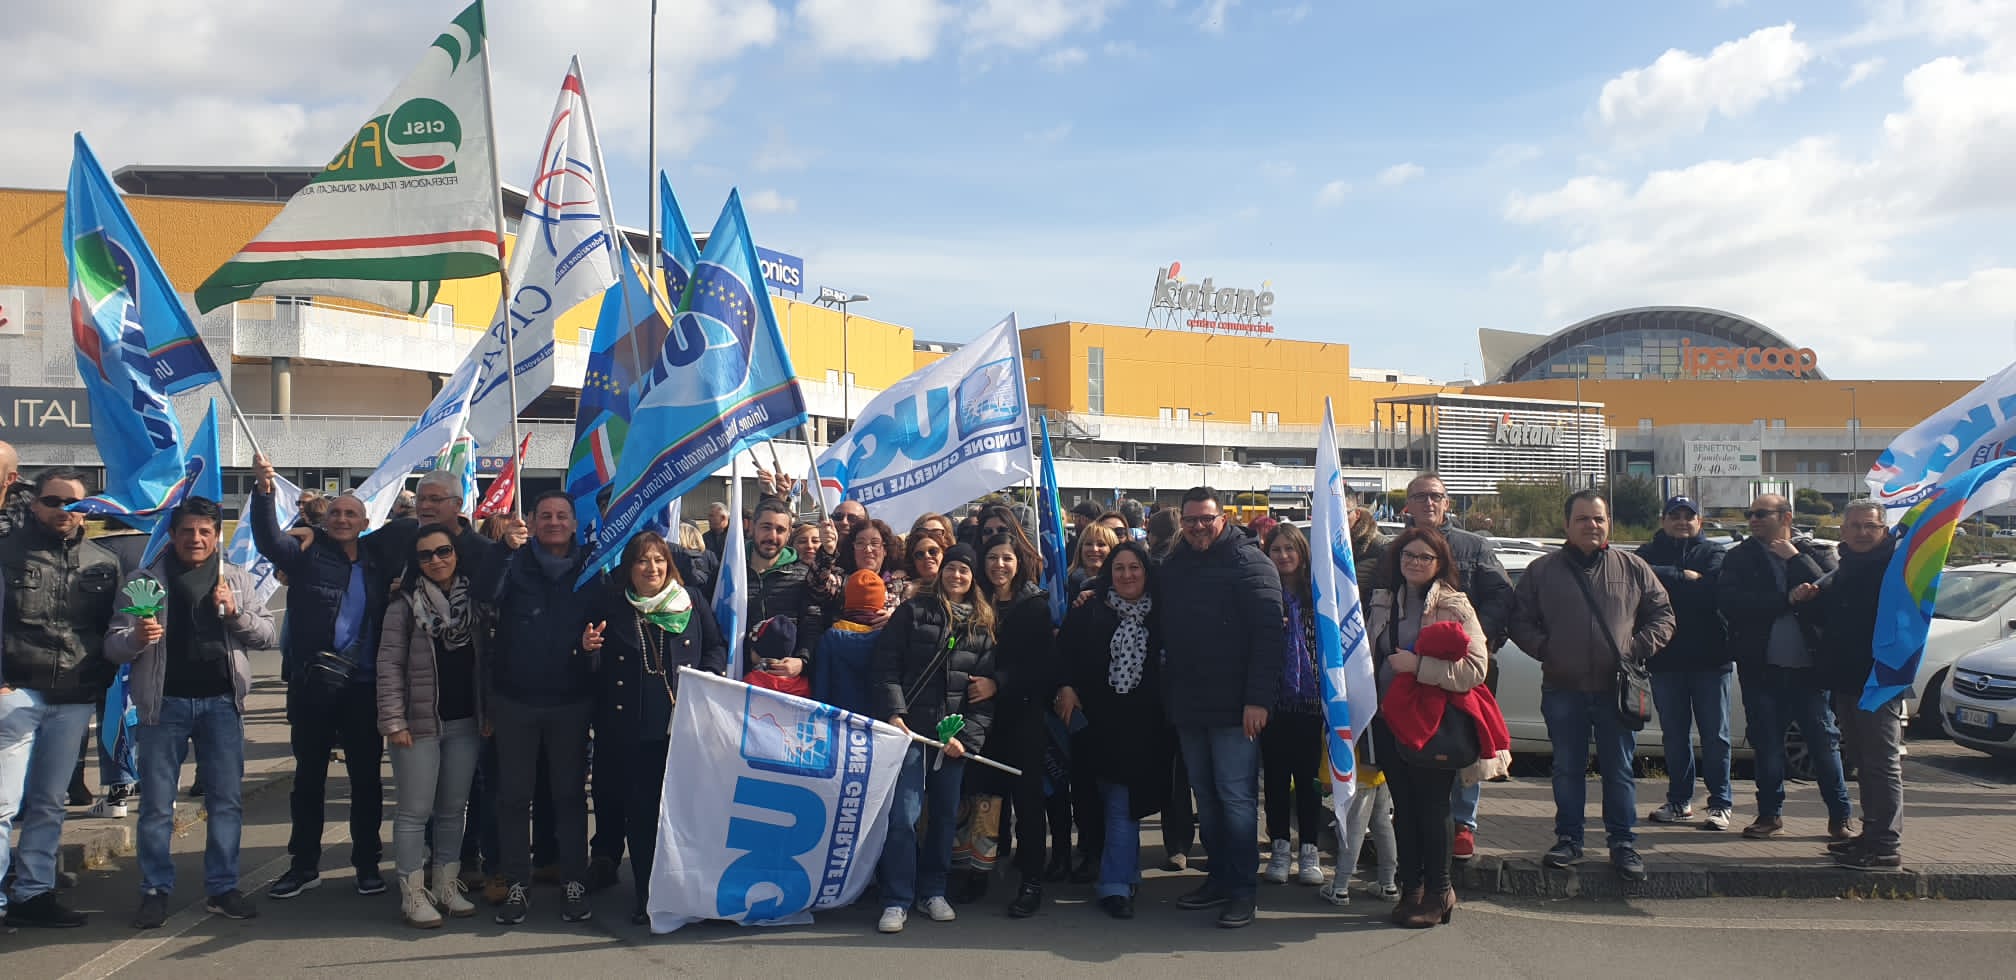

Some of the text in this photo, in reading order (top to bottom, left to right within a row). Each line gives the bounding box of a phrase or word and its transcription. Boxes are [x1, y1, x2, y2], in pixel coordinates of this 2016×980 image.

[1186, 319, 1275, 333] centro commerciale
[1682, 338, 1818, 378] ipercoop
[1692, 444, 1741, 453] BENETTON
